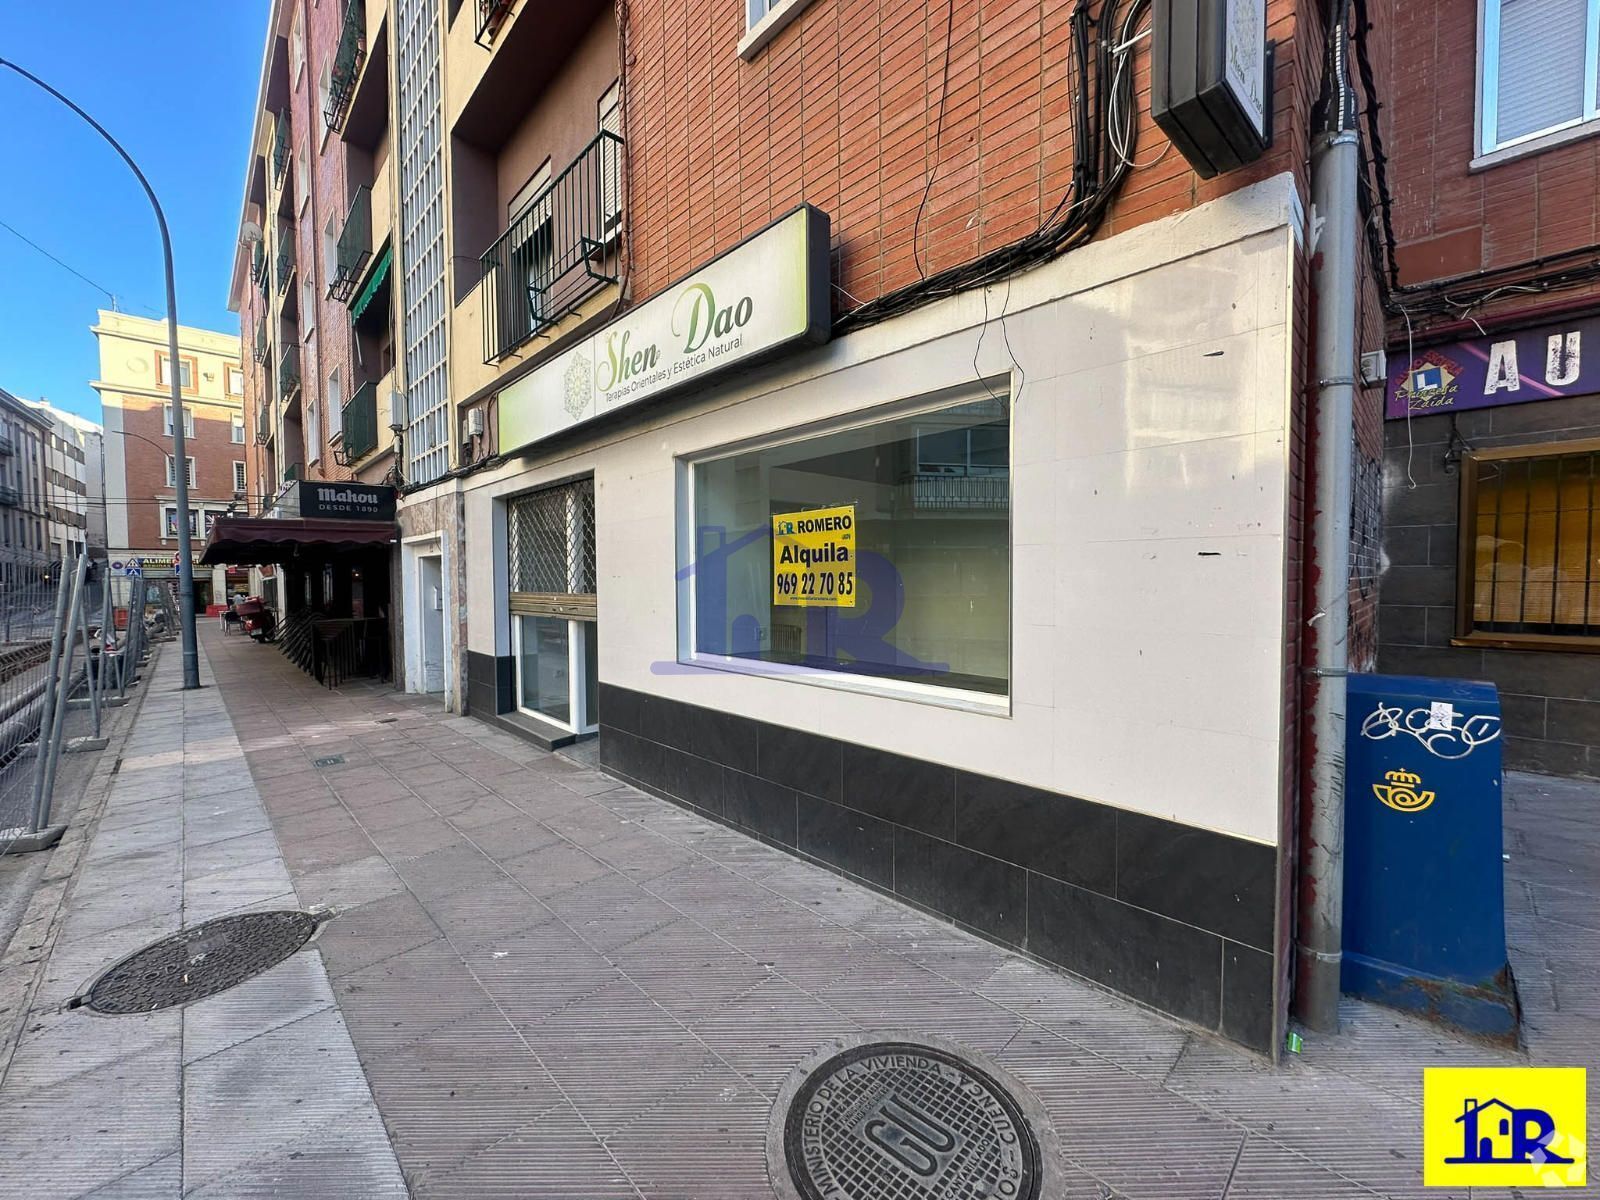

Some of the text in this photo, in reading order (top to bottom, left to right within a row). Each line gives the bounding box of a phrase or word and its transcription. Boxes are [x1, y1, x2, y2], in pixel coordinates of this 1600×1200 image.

[596, 282, 753, 392] Shen Dao
[605, 333, 743, 403] Terapias Orientales y Estética Natural
[316, 487, 378, 504] Mahou
[356, 505, 378, 513] 1890
[797, 515, 852, 533] ROMERO
[780, 542, 849, 568] Alquila
[777, 572, 853, 595] 969 22 70 85
[834, 1067, 860, 1084] LA
[860, 1055, 941, 1075] VIVIENDA
[817, 1079, 840, 1101] DE
[958, 1073, 1016, 1144] CUENCA
[803, 1101, 839, 1196] MINISTERIO
[944, 1138, 991, 1200] CANTARILLADO
